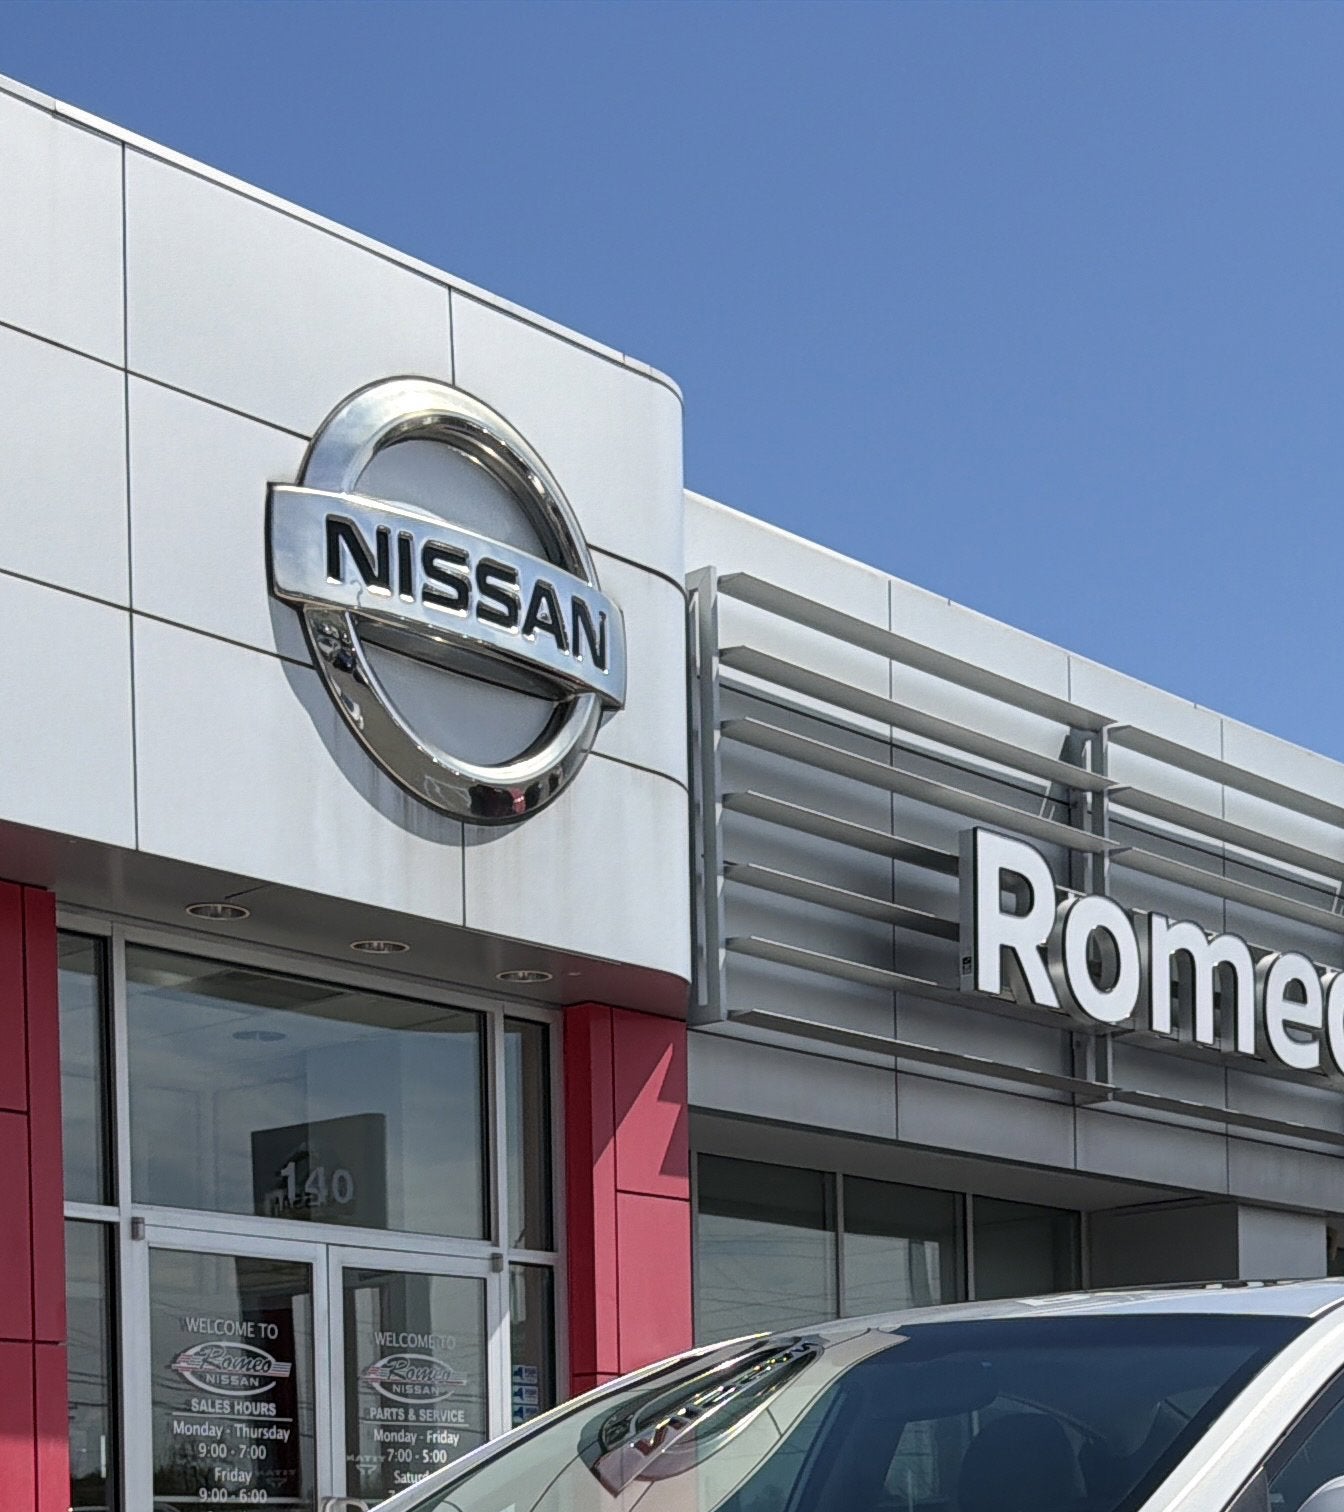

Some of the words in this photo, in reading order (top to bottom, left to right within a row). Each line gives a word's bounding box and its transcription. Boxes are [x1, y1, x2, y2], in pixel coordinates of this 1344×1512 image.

[324, 513, 609, 675] NISSAN
[281, 1161, 354, 1206] 140
[185, 1316, 256, 1336] WELCOME
[258, 1323, 279, 1340] TO
[374, 1331, 435, 1349] WELCOME
[439, 1335, 456, 1350] TO
[196, 1344, 273, 1374] Romeo
[383, 1356, 453, 1382] Romeo
[205, 1374, 260, 1387] NISSAN
[392, 1384, 440, 1396] NISSAN
[191, 1398, 231, 1413] SALES
[234, 1401, 277, 1416] HOURS
[369, 1407, 405, 1420] PARTS
[408, 1409, 417, 1420] &
[419, 1409, 465, 1423] SERVICE
[173, 1420, 224, 1441] Monday
[234, 1423, 291, 1443] Thursday
[374, 1428, 418, 1446] Monday
[427, 1430, 460, 1447] Friday
[198, 1443, 228, 1458] 9:00
[239, 1445, 267, 1460] 7:00
[387, 1448, 413, 1463] 7:00
[422, 1449, 448, 1464] 5:00
[214, 1467, 253, 1485] Friday
[199, 1488, 228, 1503] 9:00
[239, 1489, 268, 1504] 6:00
